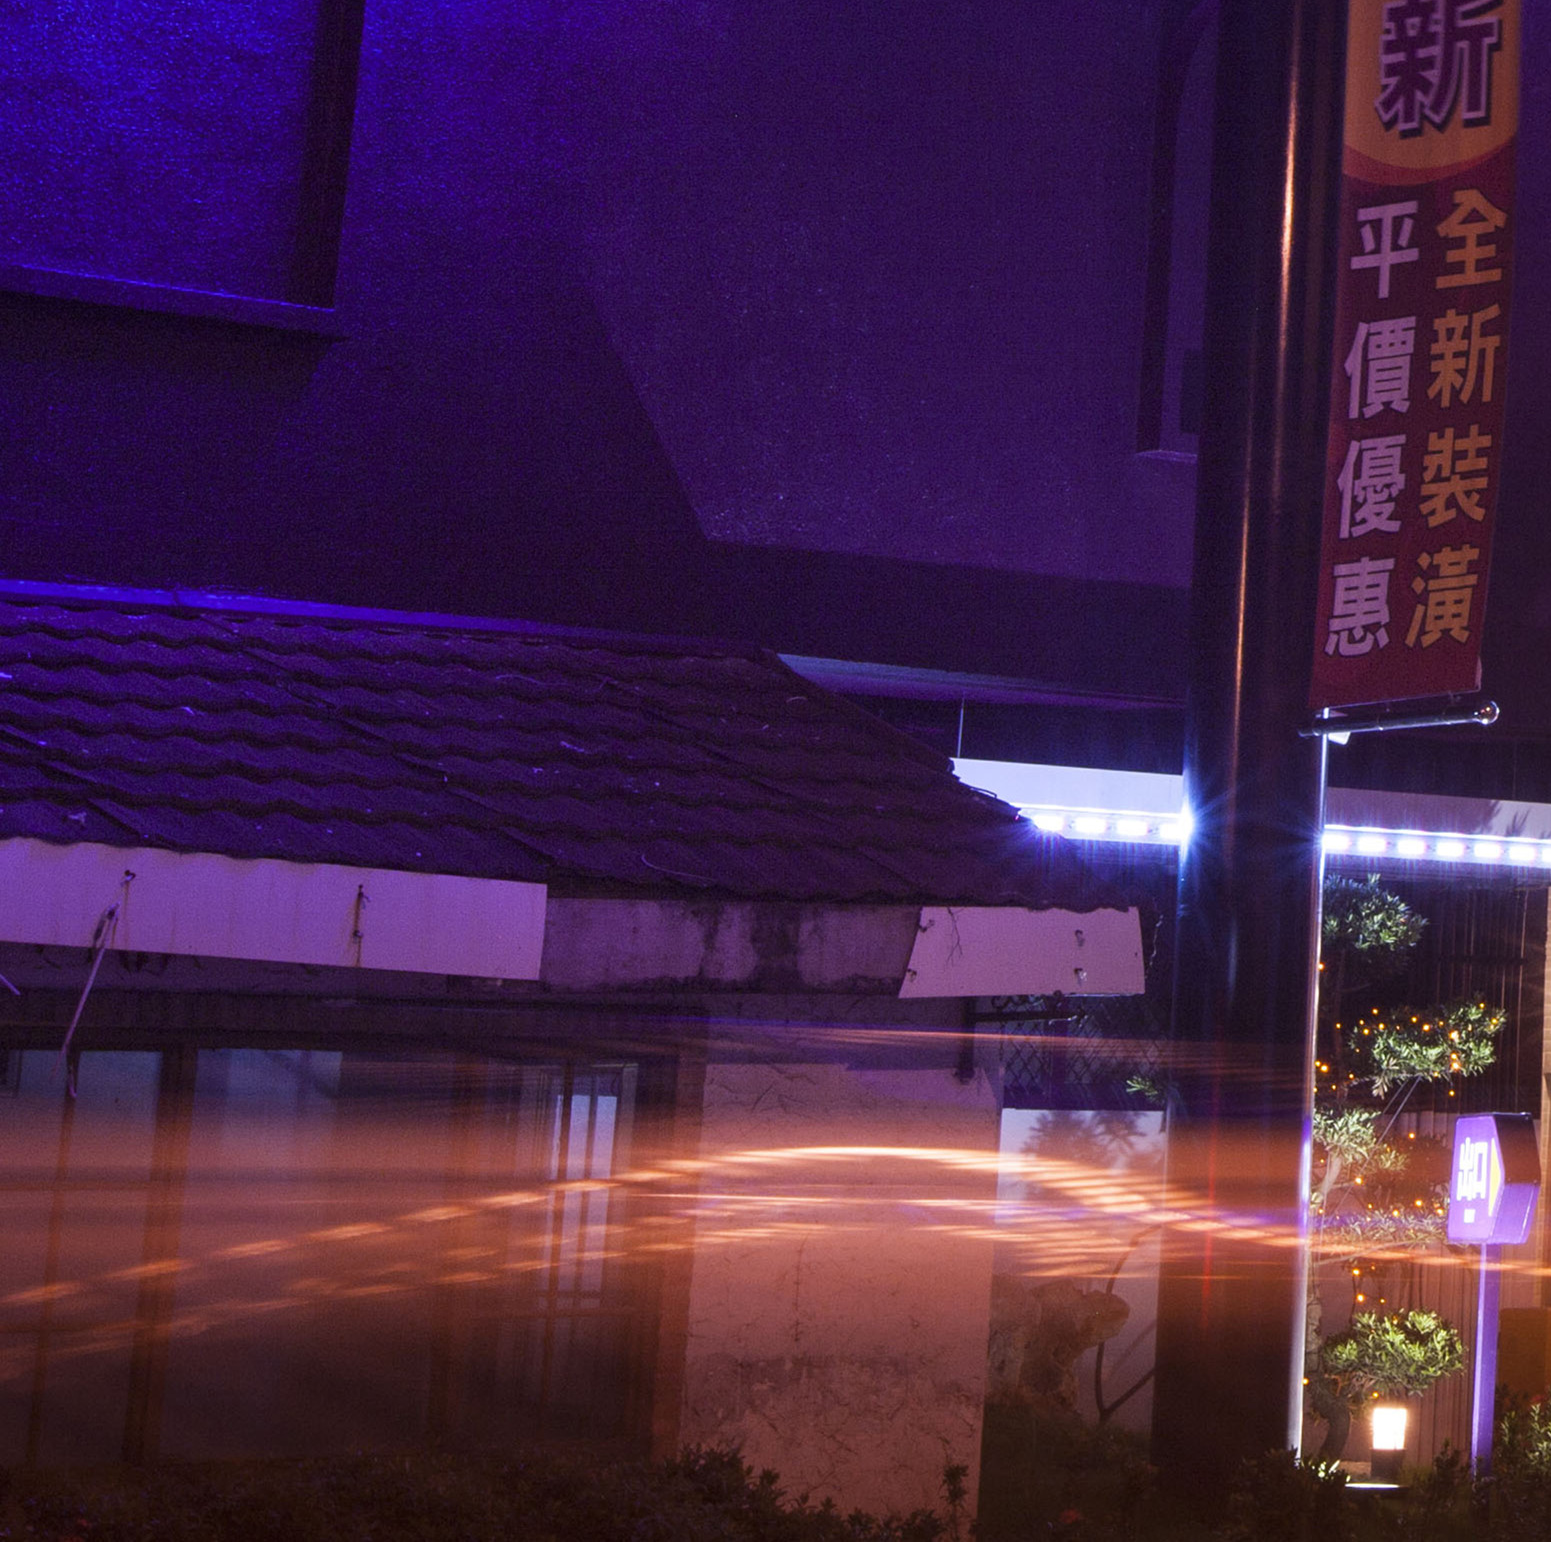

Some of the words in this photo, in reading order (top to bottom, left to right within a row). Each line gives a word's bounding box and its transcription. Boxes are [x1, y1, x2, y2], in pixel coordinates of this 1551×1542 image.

[1324, 200, 1420, 656] 平價優惠
[1404, 188, 1507, 649] 全新裝潢
[1456, 1136, 1489, 1201] 出口
